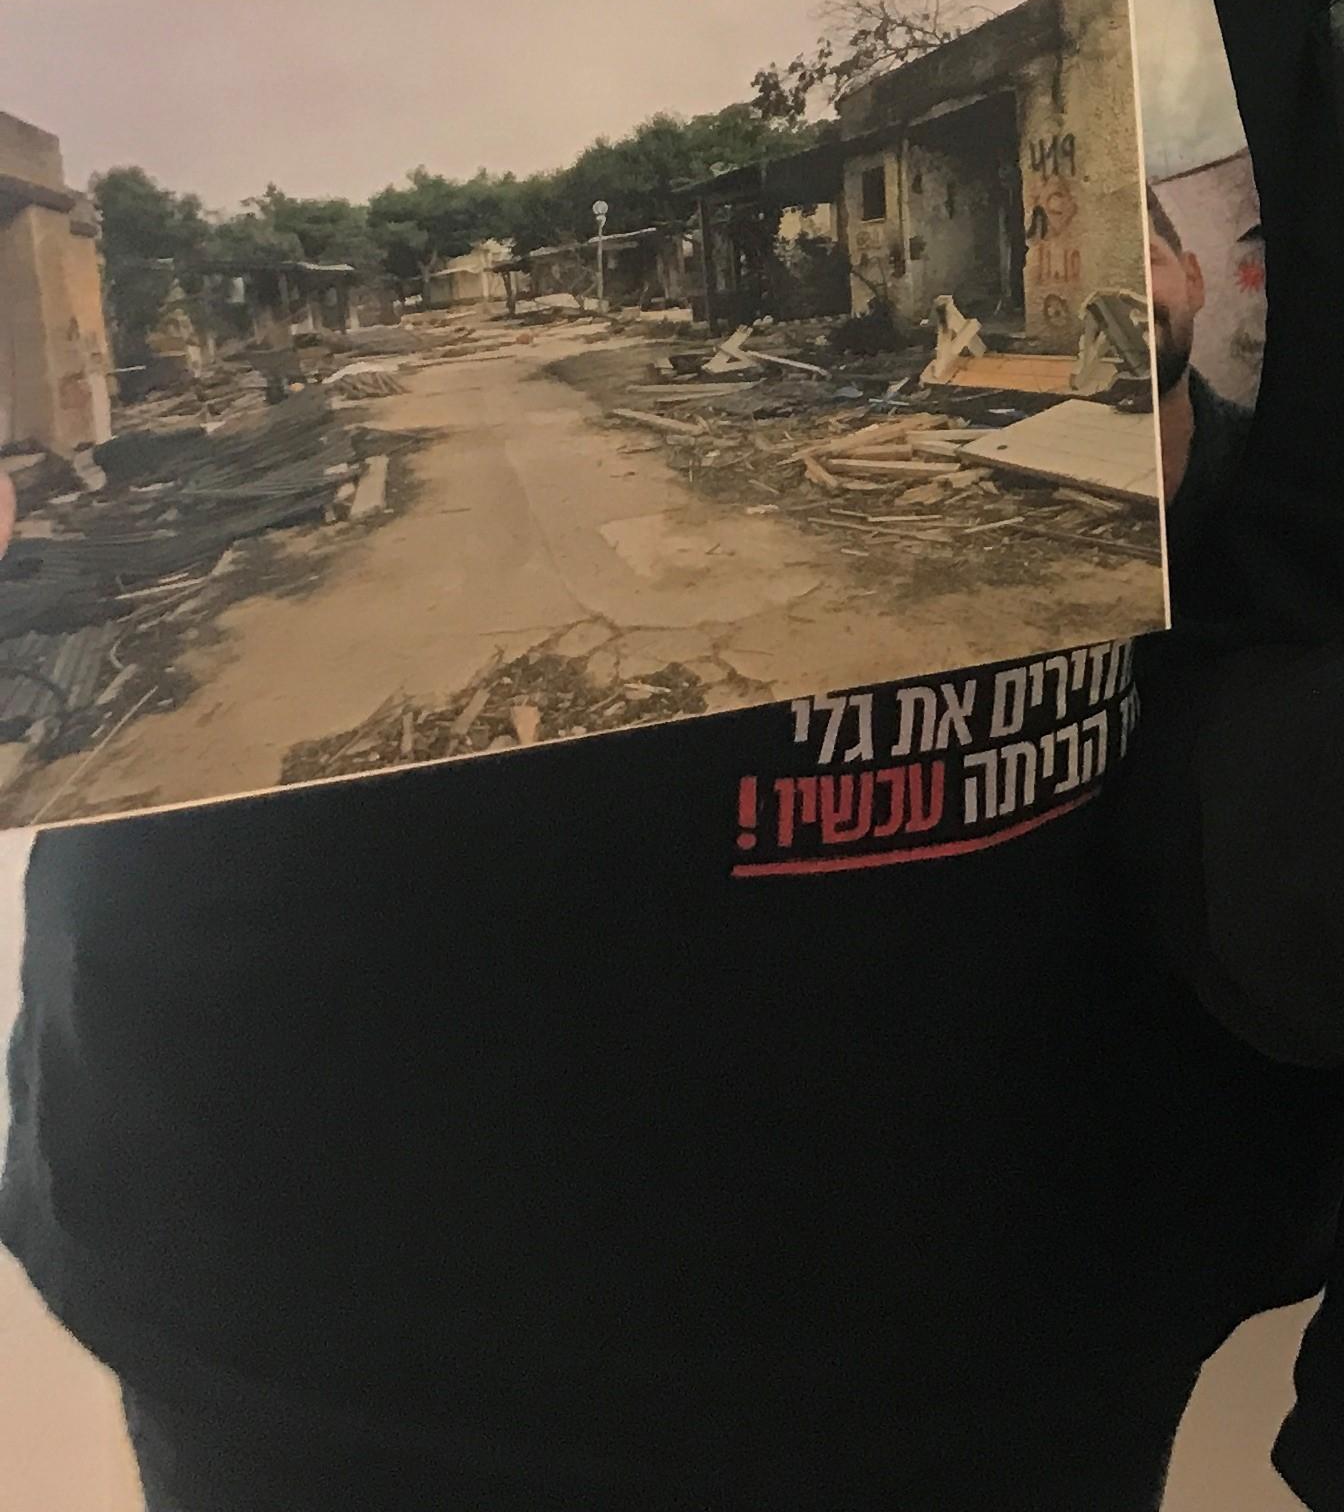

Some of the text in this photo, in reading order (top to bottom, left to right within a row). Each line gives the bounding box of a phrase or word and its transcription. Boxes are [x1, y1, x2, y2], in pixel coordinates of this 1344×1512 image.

[791, 694, 876, 765] גלי
[891, 679, 976, 757] את
[737, 760, 946, 851] עכשיו!
[962, 710, 1108, 824] הביתה
